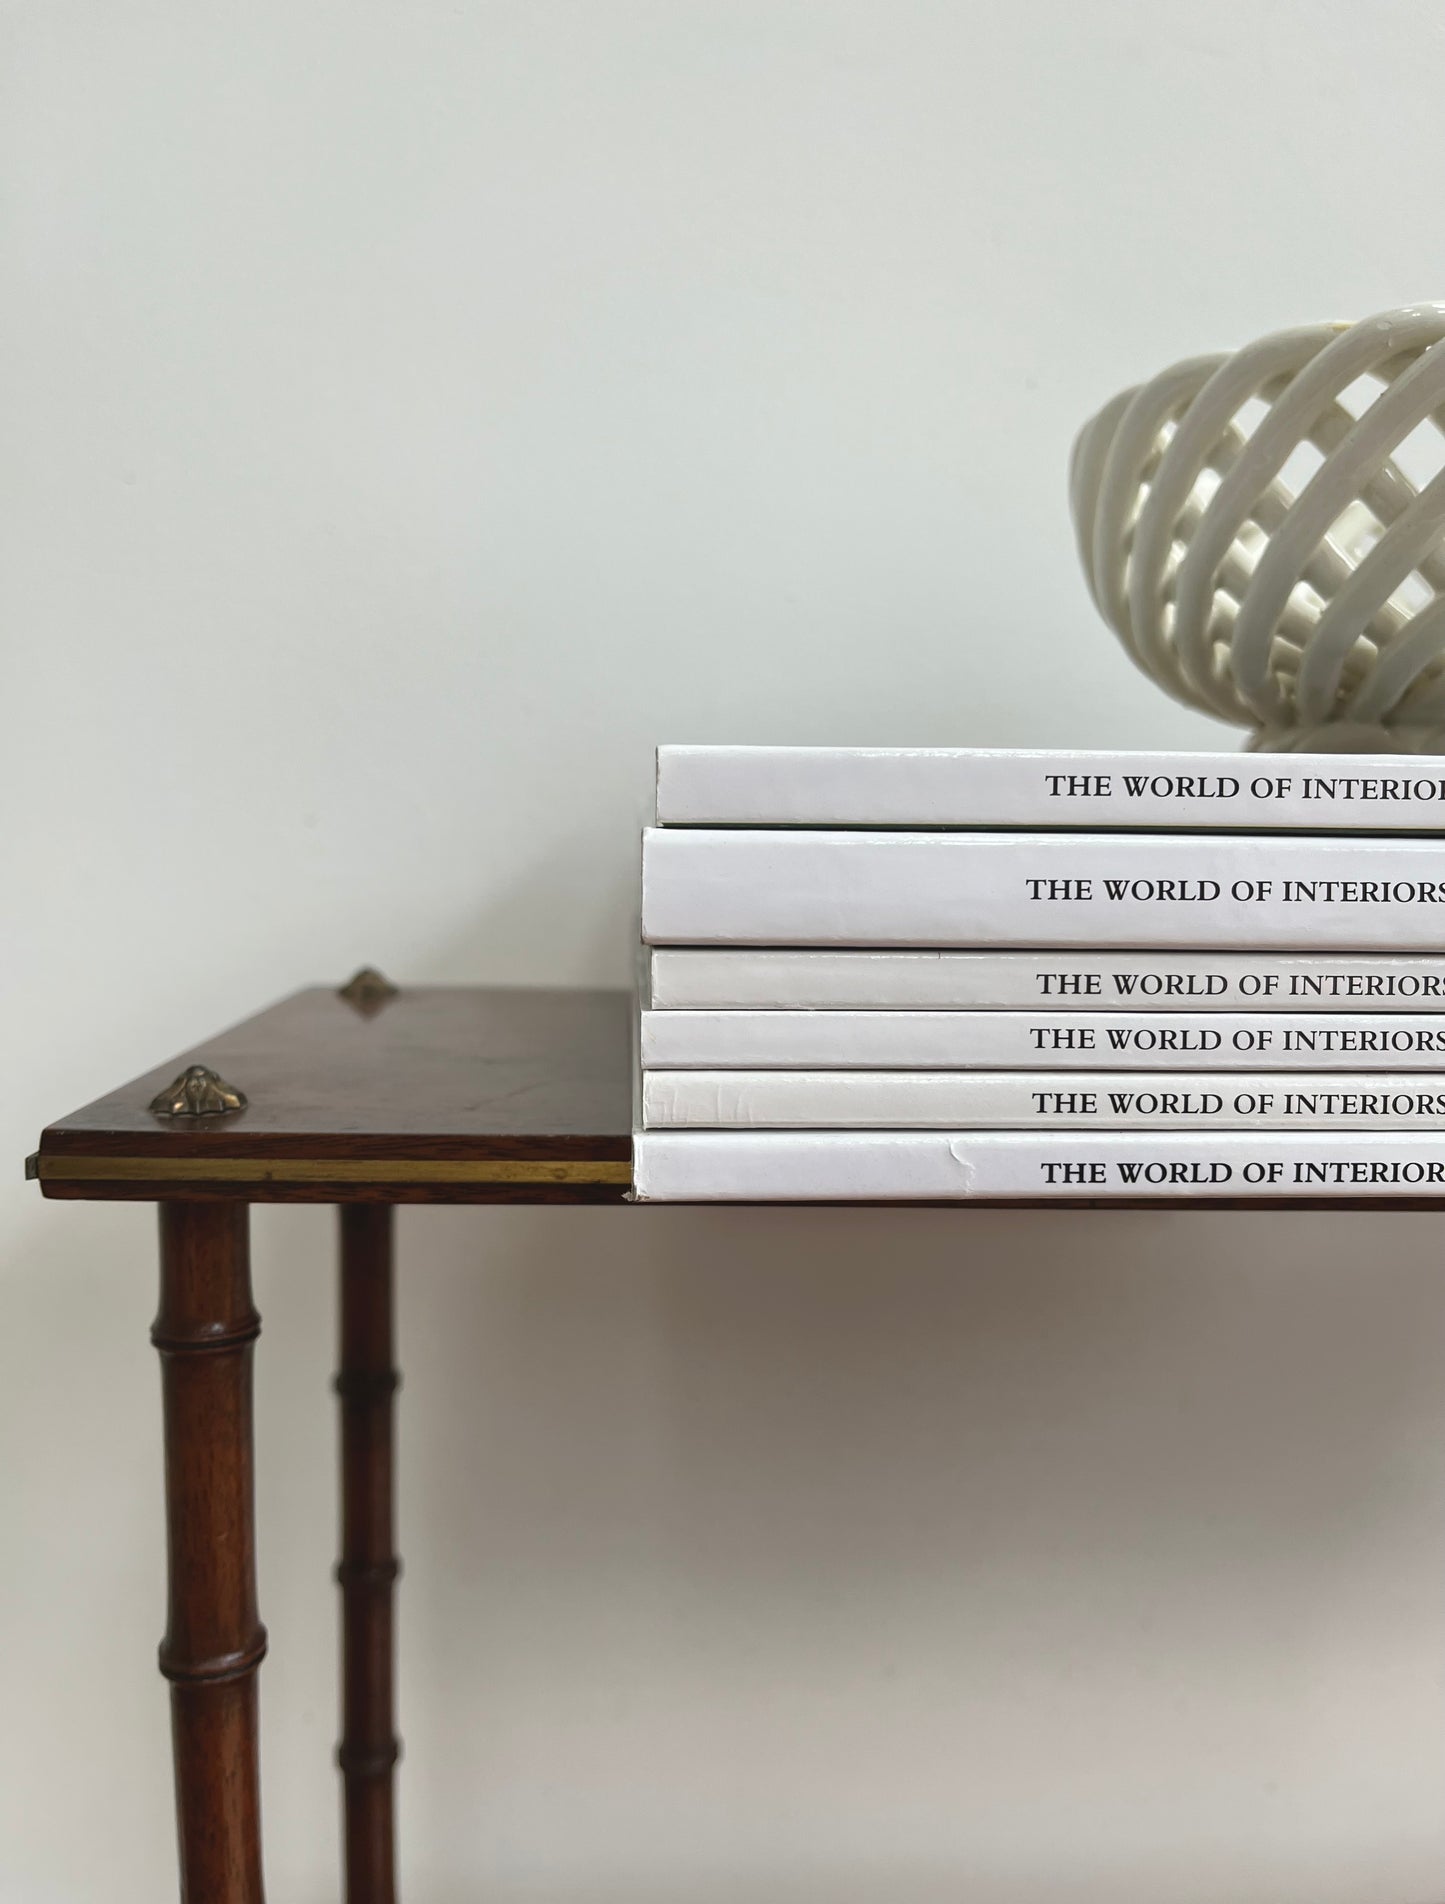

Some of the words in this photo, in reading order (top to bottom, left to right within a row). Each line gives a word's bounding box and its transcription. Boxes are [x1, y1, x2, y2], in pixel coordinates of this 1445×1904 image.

[1044, 775, 1112, 797] THE
[1121, 776, 1240, 798] WORLD
[1250, 777, 1292, 799] OF
[1025, 879, 1093, 901] THE
[1102, 879, 1221, 901] WORLD
[1231, 880, 1273, 902] OF
[1035, 973, 1102, 995] THE
[1111, 974, 1228, 996] WORLD
[1238, 974, 1279, 996] OF
[1288, 975, 1445, 997] INTERIOR
[1029, 1028, 1096, 1049] THE
[1105, 1029, 1222, 1051] WORLD
[1232, 1029, 1273, 1051] OF
[1282, 1030, 1445, 1052] INTERIORS
[1031, 1092, 1098, 1114] THE
[1107, 1093, 1223, 1115] WORLD
[1233, 1093, 1274, 1115] OF
[1283, 1094, 1445, 1116] INTERIORS
[1040, 1162, 1107, 1184] THE
[1116, 1162, 1233, 1184] WORLD
[1242, 1162, 1284, 1184] OF
[1292, 1162, 1445, 1184] INTERIOR
